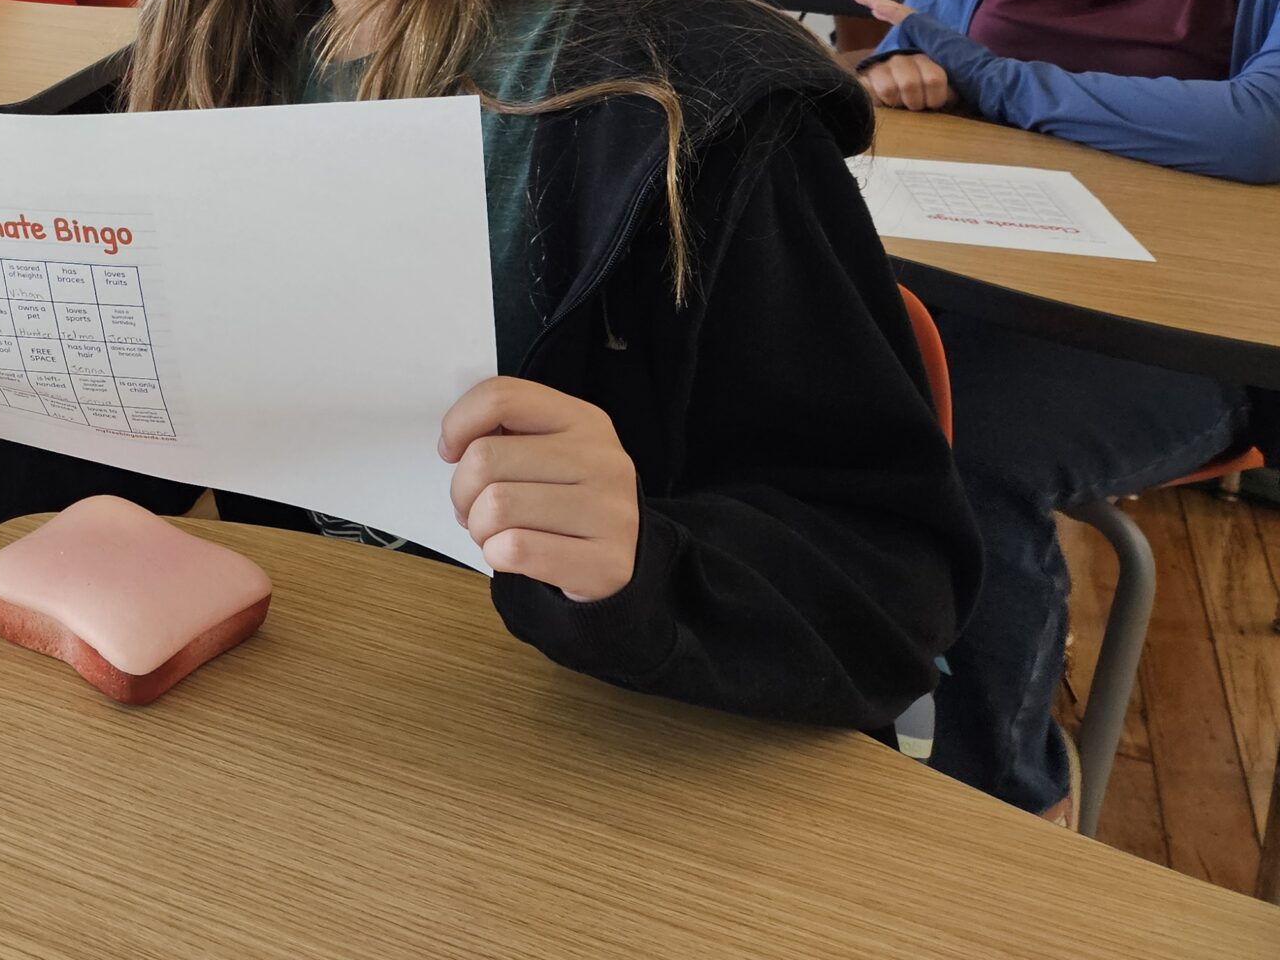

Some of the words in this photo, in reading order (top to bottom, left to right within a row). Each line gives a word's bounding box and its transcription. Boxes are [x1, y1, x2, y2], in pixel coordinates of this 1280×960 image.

[53, 217, 133, 255] Bingo
[62, 267, 77, 275] has
[104, 270, 126, 278] loves
[17, 272, 43, 280] heights
[57, 275, 85, 284] braces
[84, 345, 101, 353] long
[30, 355, 56, 363] SPACE
[138, 382, 156, 390] only
